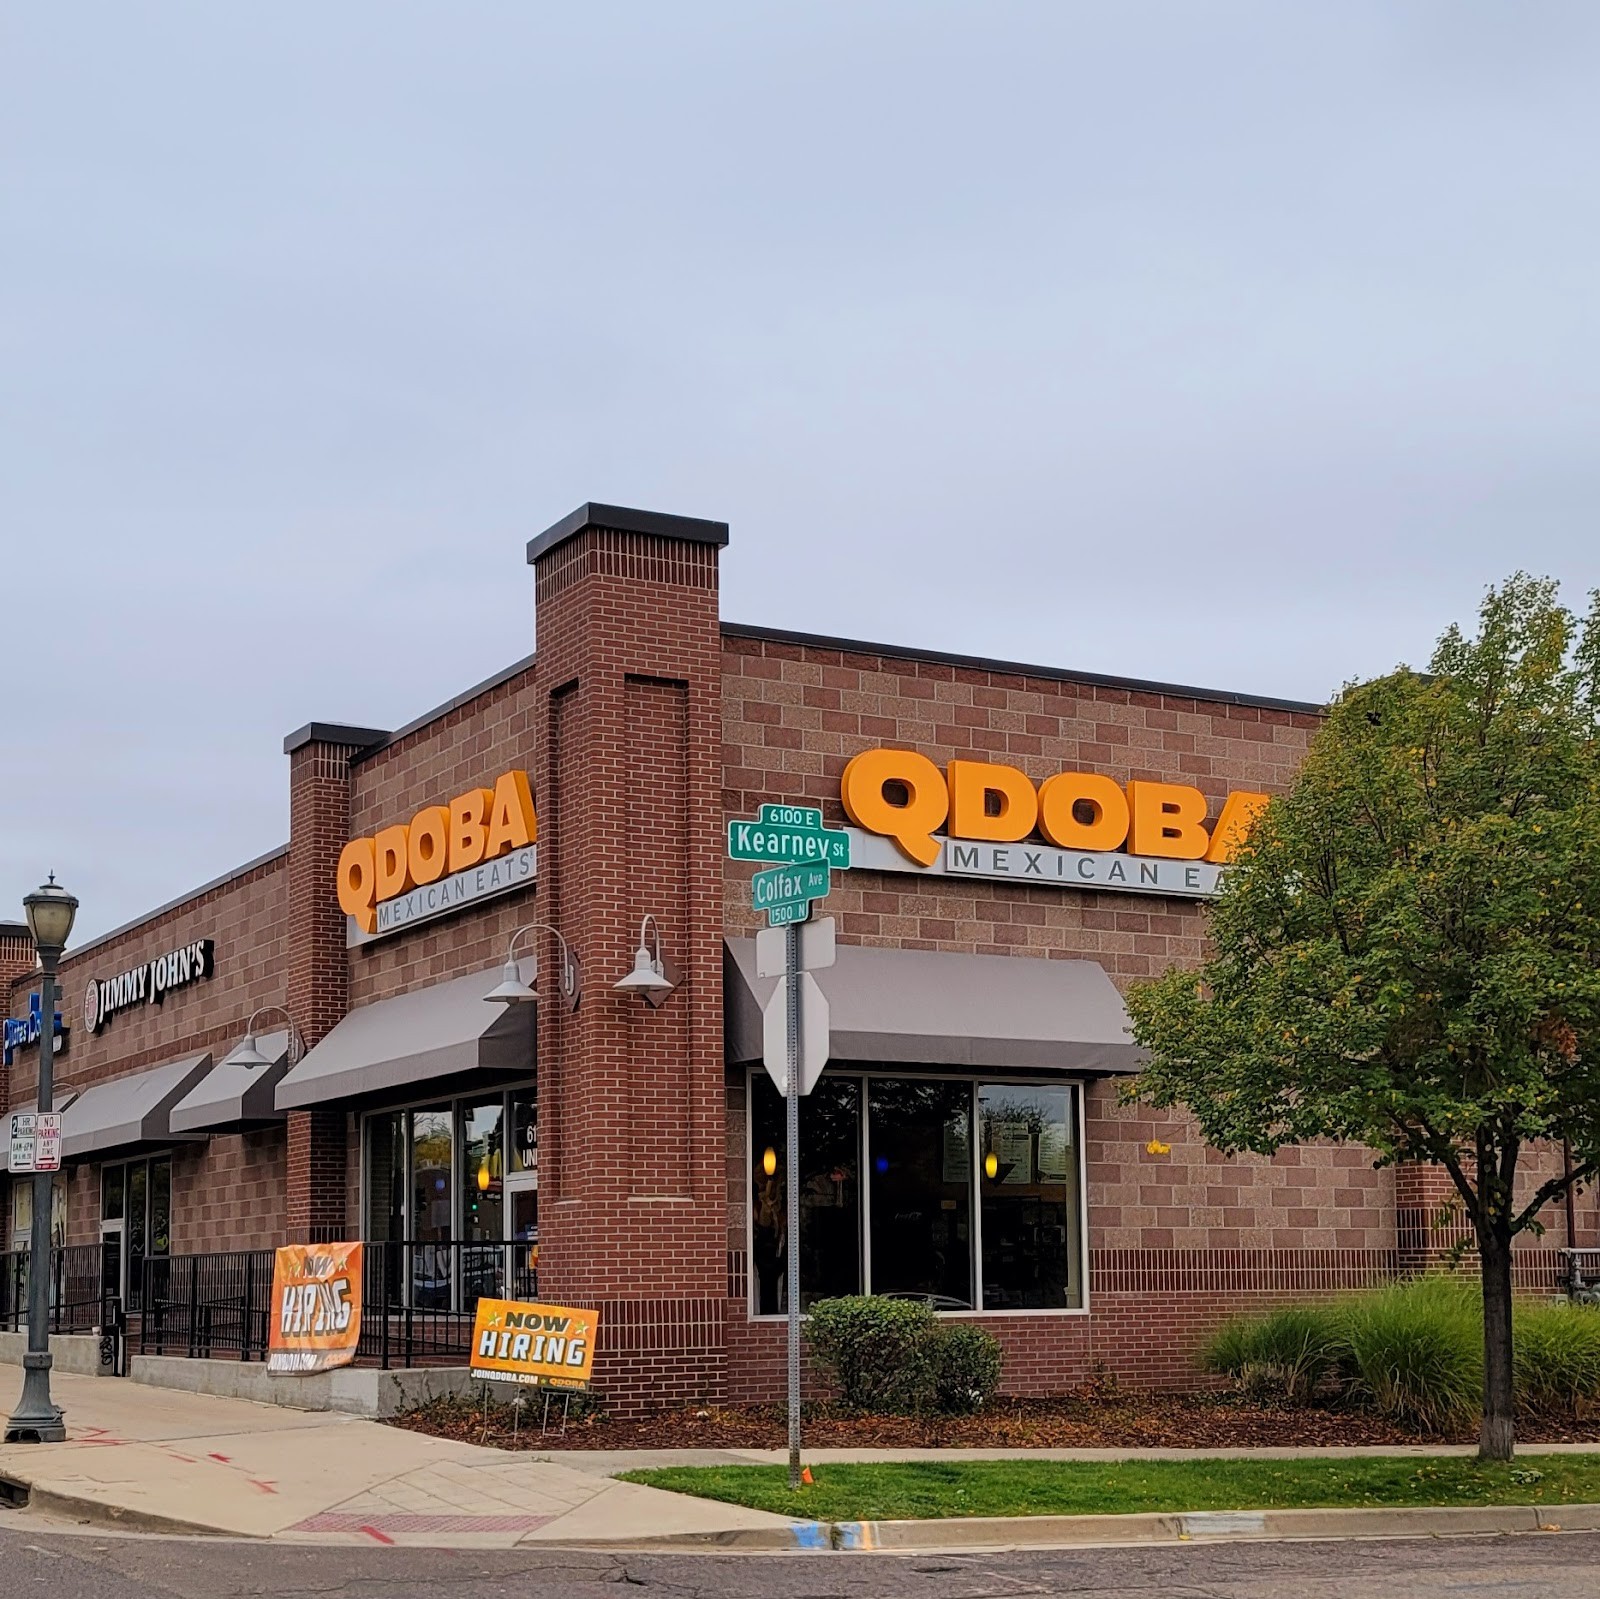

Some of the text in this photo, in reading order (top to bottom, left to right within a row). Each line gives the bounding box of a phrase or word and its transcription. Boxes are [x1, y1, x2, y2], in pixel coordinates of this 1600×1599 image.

[769, 808, 815, 826] 6100 E
[337, 770, 537, 934] QDOBA
[737, 824, 845, 859] Kearney St
[953, 845, 1159, 885] MEXICAN
[378, 851, 530, 928] MEXICAN EATS
[756, 872, 823, 904] Colfax Ave
[771, 903, 806, 923] 1500 N
[99, 964, 148, 1024] JIMMY
[149, 939, 205, 1005] JOHN'S
[12, 1117, 31, 1136] 2 HR
[38, 1127, 60, 1139] PARKING
[44, 1116, 54, 1128] NO
[522, 1148, 538, 1168] UNI
[505, 1311, 571, 1334] NOW
[479, 1330, 586, 1366] HIRING
[470, 1369, 538, 1385] JOINQDOBA.COM
[549, 1377, 586, 1388] QDOBA
